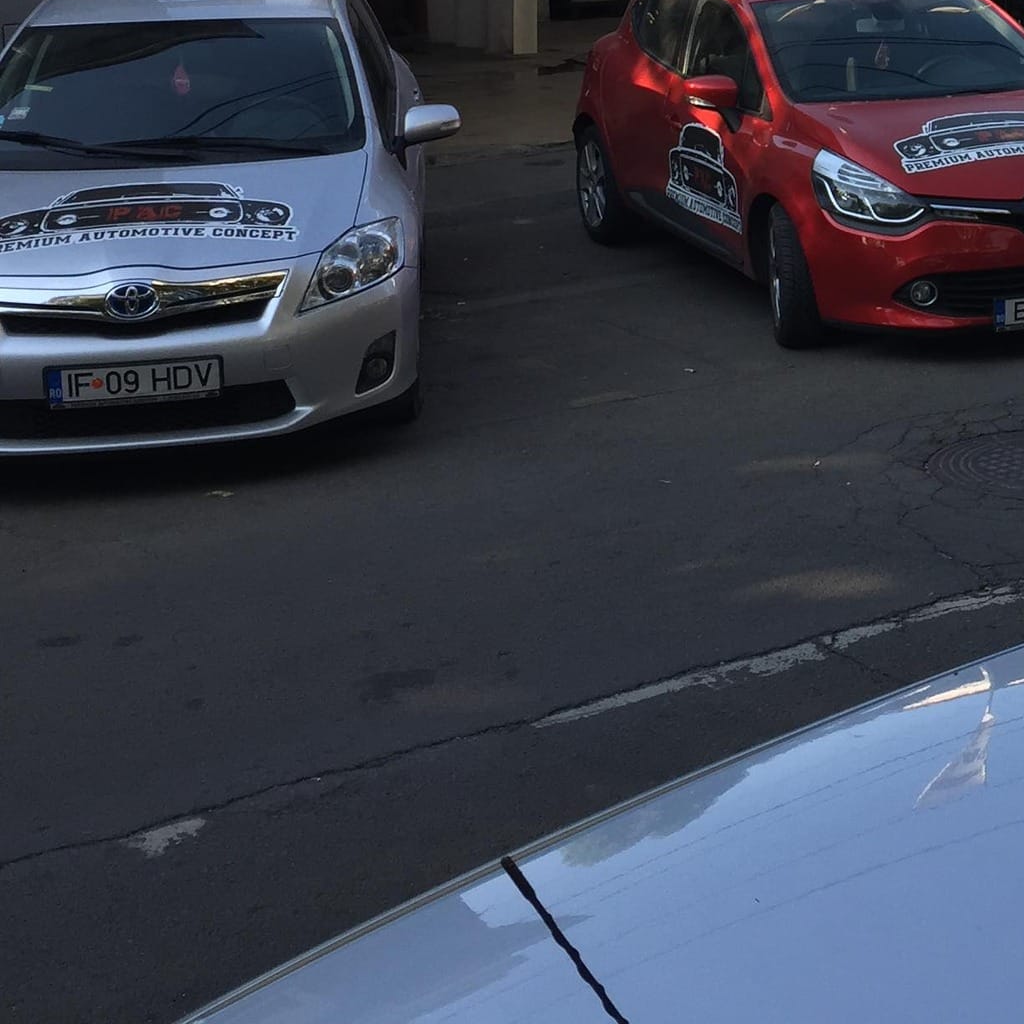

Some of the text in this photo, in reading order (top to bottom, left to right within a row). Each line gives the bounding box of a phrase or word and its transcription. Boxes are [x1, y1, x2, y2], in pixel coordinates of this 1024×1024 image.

[905, 152, 971, 171] PREMIUM
[0, 227, 297, 253] EMIUM AUTOMOTIVE CONCEPT
[68, 363, 212, 397] IF 09 HDV
[49, 388, 62, 399] RO
